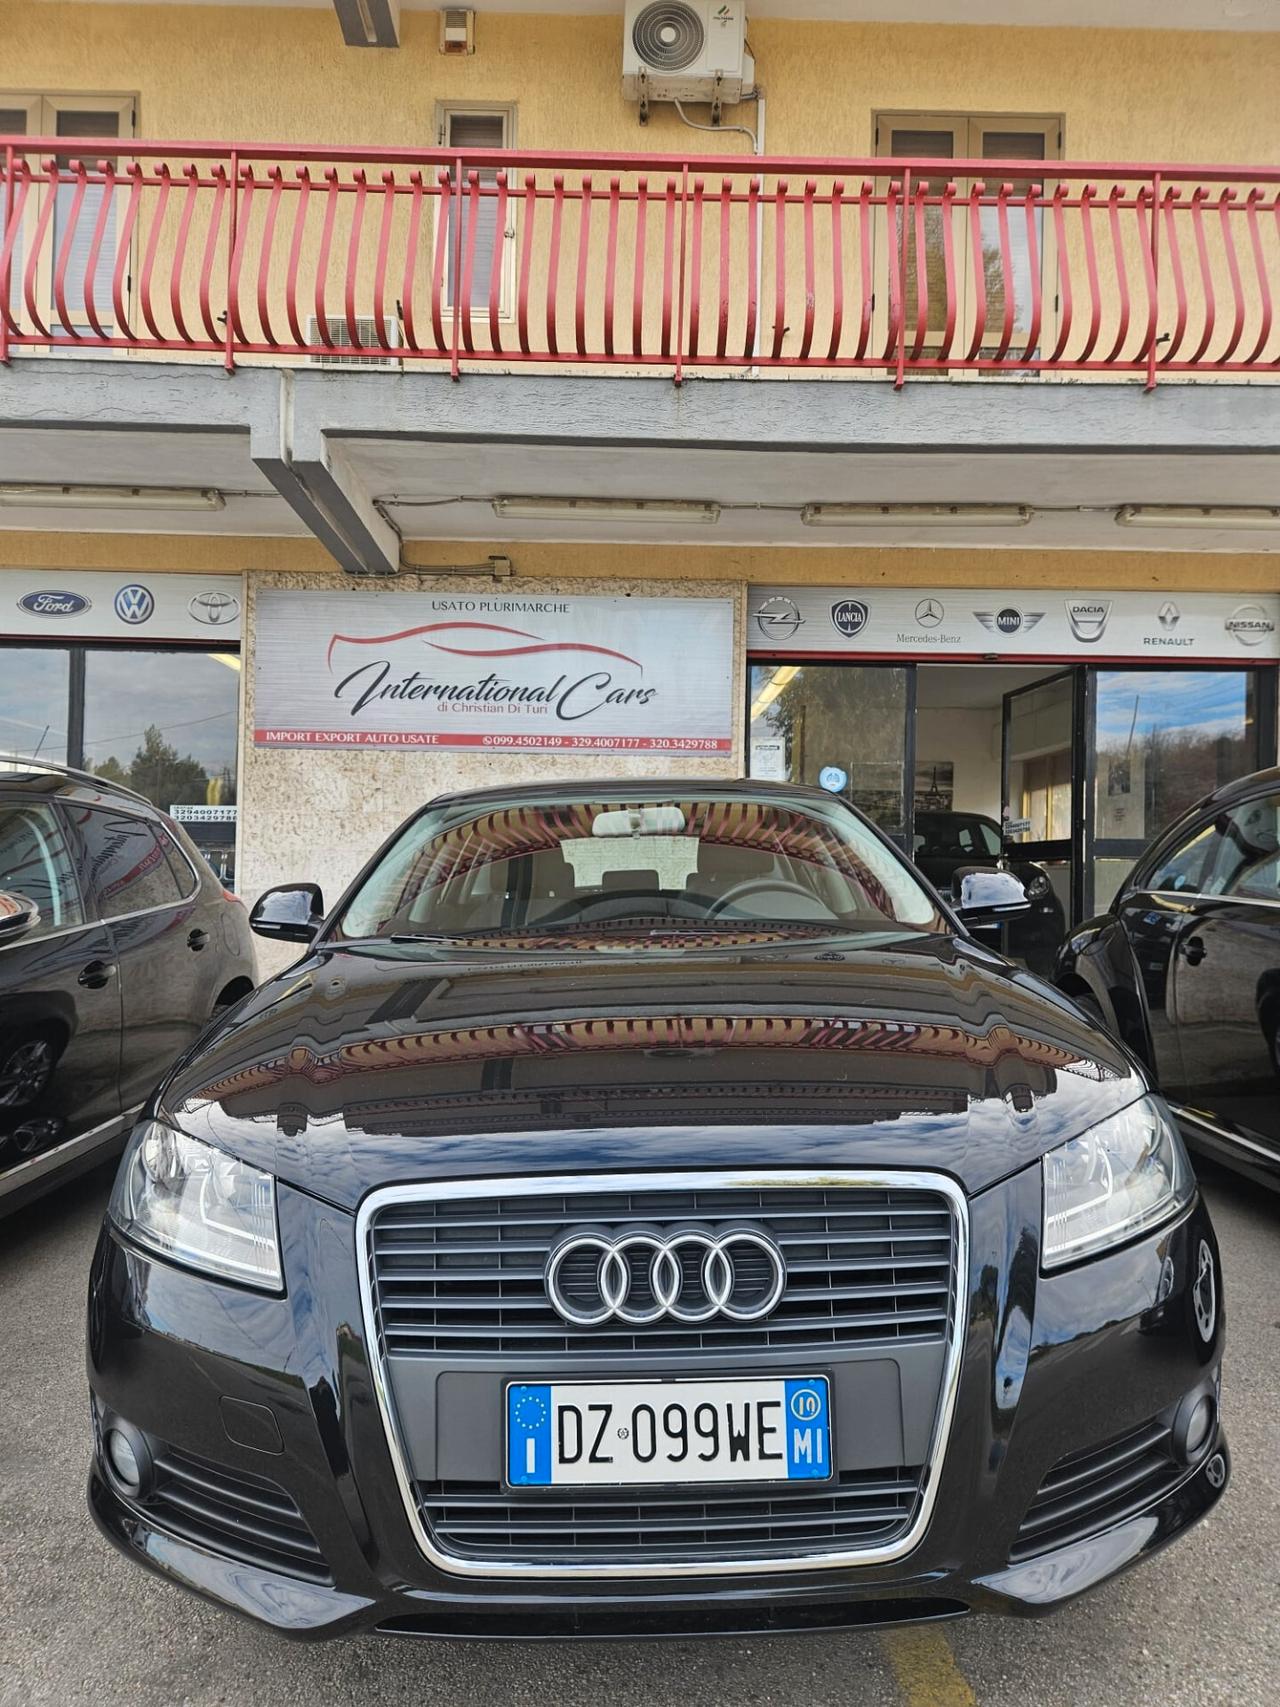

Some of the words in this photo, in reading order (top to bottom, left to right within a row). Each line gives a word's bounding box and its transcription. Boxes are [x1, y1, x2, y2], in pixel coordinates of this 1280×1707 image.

[33, 594, 75, 613] Ford
[431, 600, 476, 612] USATO
[479, 601, 570, 613] PLURIMARCHE
[1072, 606, 1105, 614] DACIA
[838, 611, 862, 622] LANCIA
[997, 616, 1020, 626] MINI
[896, 634, 961, 644] Mercedes-Benz
[1143, 638, 1195, 646] RENAULT
[334, 660, 567, 717] International
[556, 672, 659, 721] Cars
[437, 702, 448, 712] di
[452, 703, 504, 713] Christian
[507, 704, 520, 713] Di
[524, 704, 548, 714] Turi
[266, 731, 312, 742] IMPORT
[315, 732, 362, 743] EXPORT
[364, 733, 399, 744] AUTO
[402, 734, 439, 744] USATE
[493, 735, 562, 747] 099.4502149
[571, 737, 640, 748] 329.4007177
[649, 738, 718, 749] 320.3429788
[794, 1428, 823, 1464] MI
[526, 1438, 535, 1473] I
